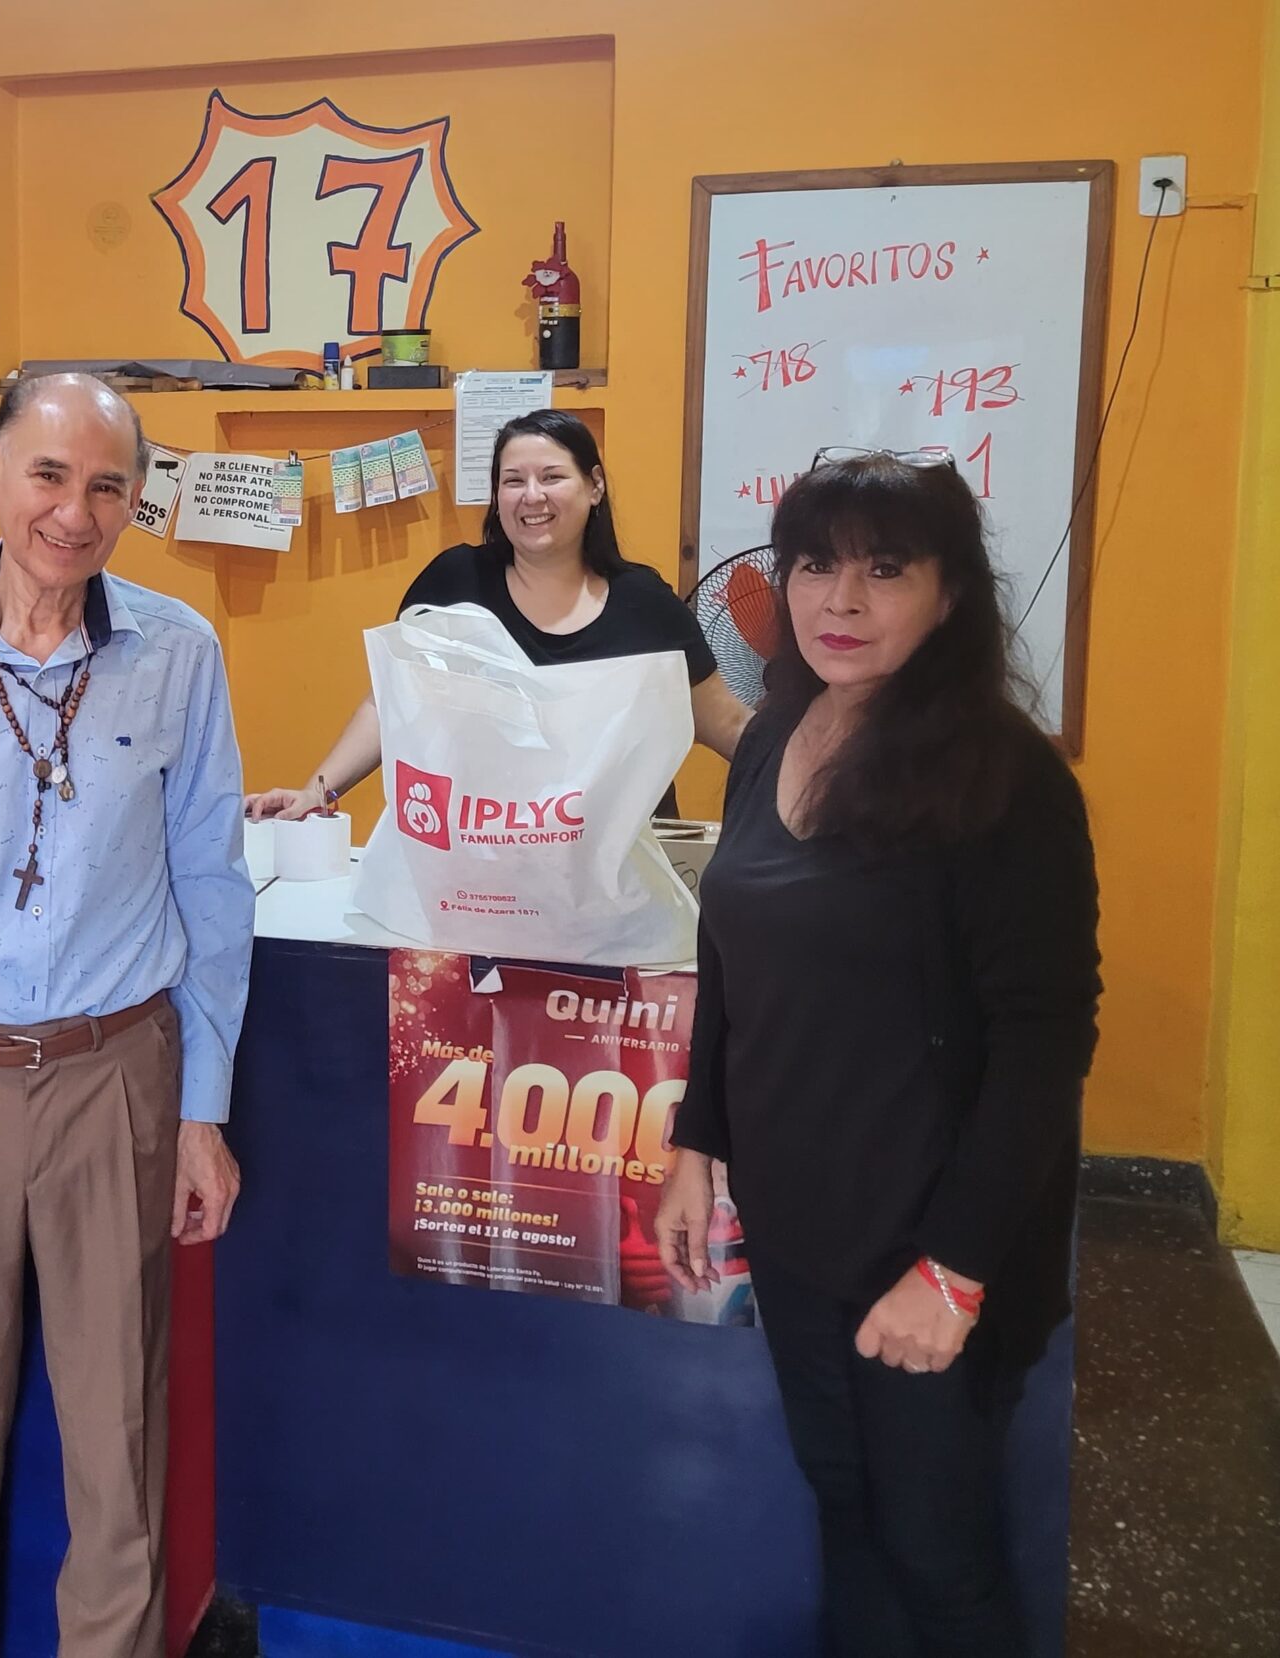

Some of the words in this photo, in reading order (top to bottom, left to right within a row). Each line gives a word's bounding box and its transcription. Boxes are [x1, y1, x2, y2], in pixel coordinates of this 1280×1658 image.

[206, 148, 424, 335] 17
[738, 239, 956, 312] FAVORITOS
[749, 343, 816, 391] 718
[214, 461, 226, 470] SR
[228, 463, 273, 475] CLIENTE
[199, 472, 212, 481] NO
[215, 473, 247, 483] PASAR
[250, 476, 273, 487] ATR
[195, 483, 212, 492] DEL
[215, 485, 273, 499] MOSTRADO
[194, 495, 207, 504] NO
[210, 496, 273, 511] COMPROME
[136, 511, 155, 526] DO
[199, 508, 211, 516] AL
[214, 509, 270, 523] PERSONAL
[459, 791, 584, 830] IPLYC
[460, 833, 516, 845] FAMILIA
[519, 829, 584, 845] CONFORT
[545, 990, 678, 1032] Quini
[421, 1039, 464, 1060] Más
[468, 1044, 494, 1064] de
[591, 1033, 680, 1053] ANIVERSARIO
[508, 1143, 665, 1186] millones
[416, 1182, 453, 1199] Sale
[457, 1188, 466, 1200] o
[472, 1187, 514, 1205] sale:
[476, 1207, 558, 1228] millones!
[414, 1217, 465, 1235] ¡Sortea
[469, 1221, 482, 1236] el
[485, 1224, 499, 1238] 11
[502, 1225, 519, 1240] de
[522, 1229, 576, 1248] agosto!
